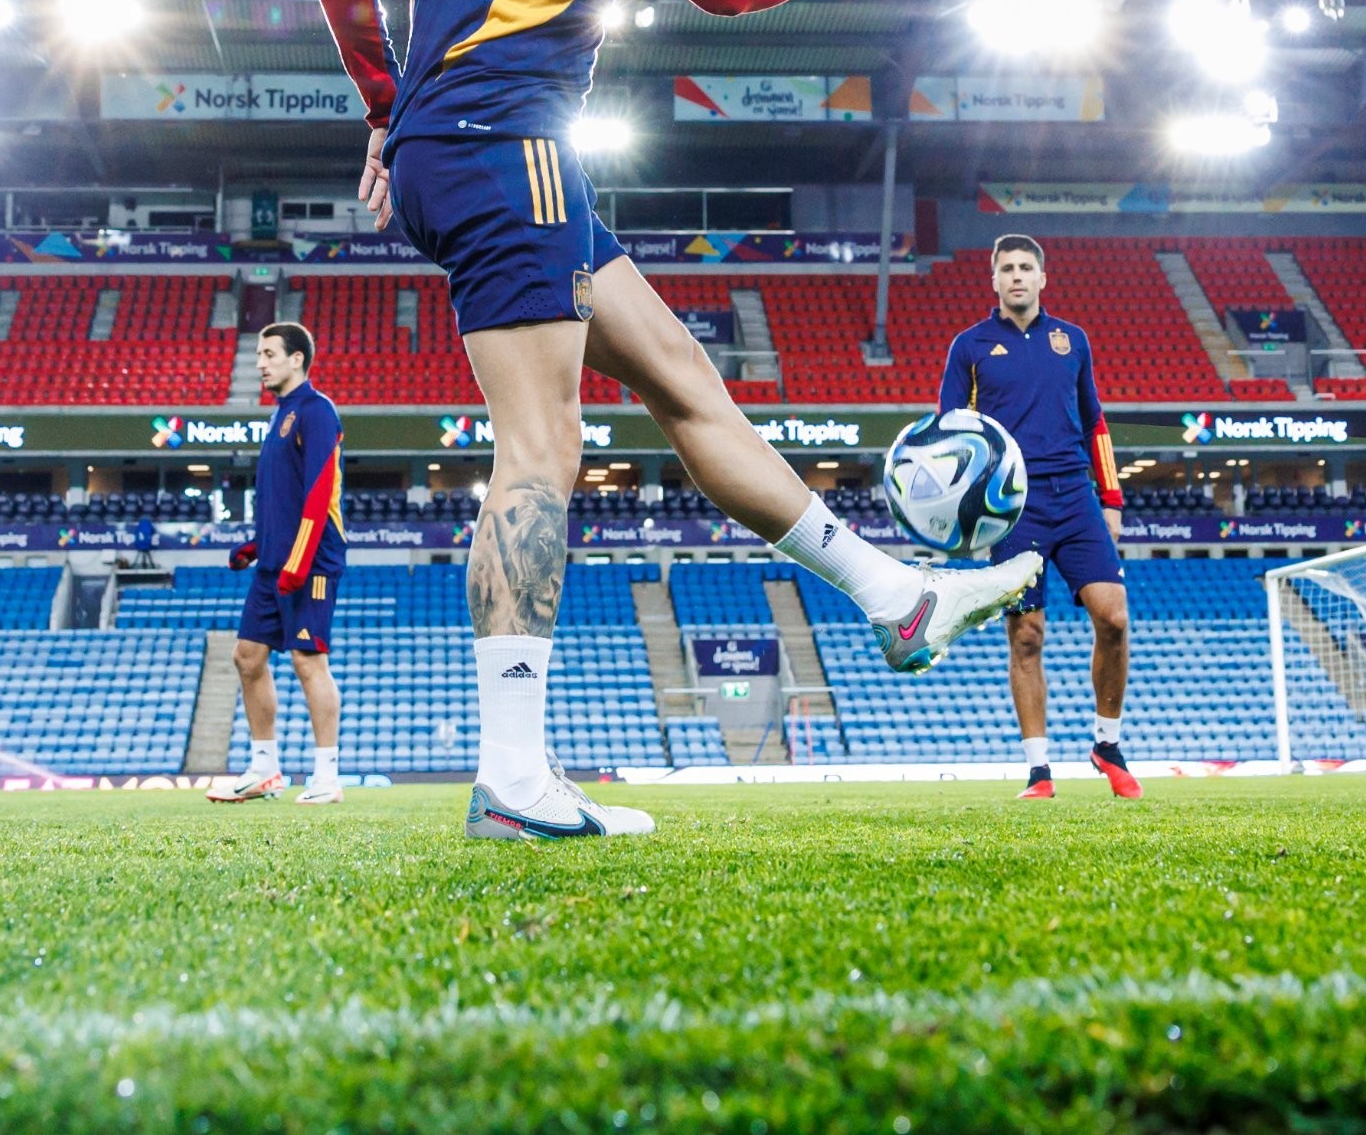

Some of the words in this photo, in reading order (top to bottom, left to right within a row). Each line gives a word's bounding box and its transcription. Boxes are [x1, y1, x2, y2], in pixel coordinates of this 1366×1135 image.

[195, 89, 260, 109] Norsk
[266, 90, 348, 113] Tipping
[119, 242, 157, 255] Norsk
[159, 242, 207, 258] Tipping
[350, 242, 388, 255] Norsk
[390, 242, 421, 258] Tipp
[188, 423, 248, 443] Norsk
[785, 420, 859, 446] Tipping
[1216, 418, 1272, 440] Norsk
[1274, 417, 1347, 442] Tipping
[80, 531, 115, 544] Norsk
[115, 529, 160, 546] Tipg
[210, 529, 246, 543] Norsk
[345, 529, 377, 543] Norsk
[379, 528, 423, 544] Tipping
[603, 528, 637, 541] Norsk
[638, 527, 681, 543] Tipping
[860, 526, 893, 538] Norsk
[1149, 523, 1192, 539] Tipping
[1239, 524, 1273, 536] Norsk
[1276, 523, 1316, 538] Tipping
[501, 670, 537, 679] adidas
